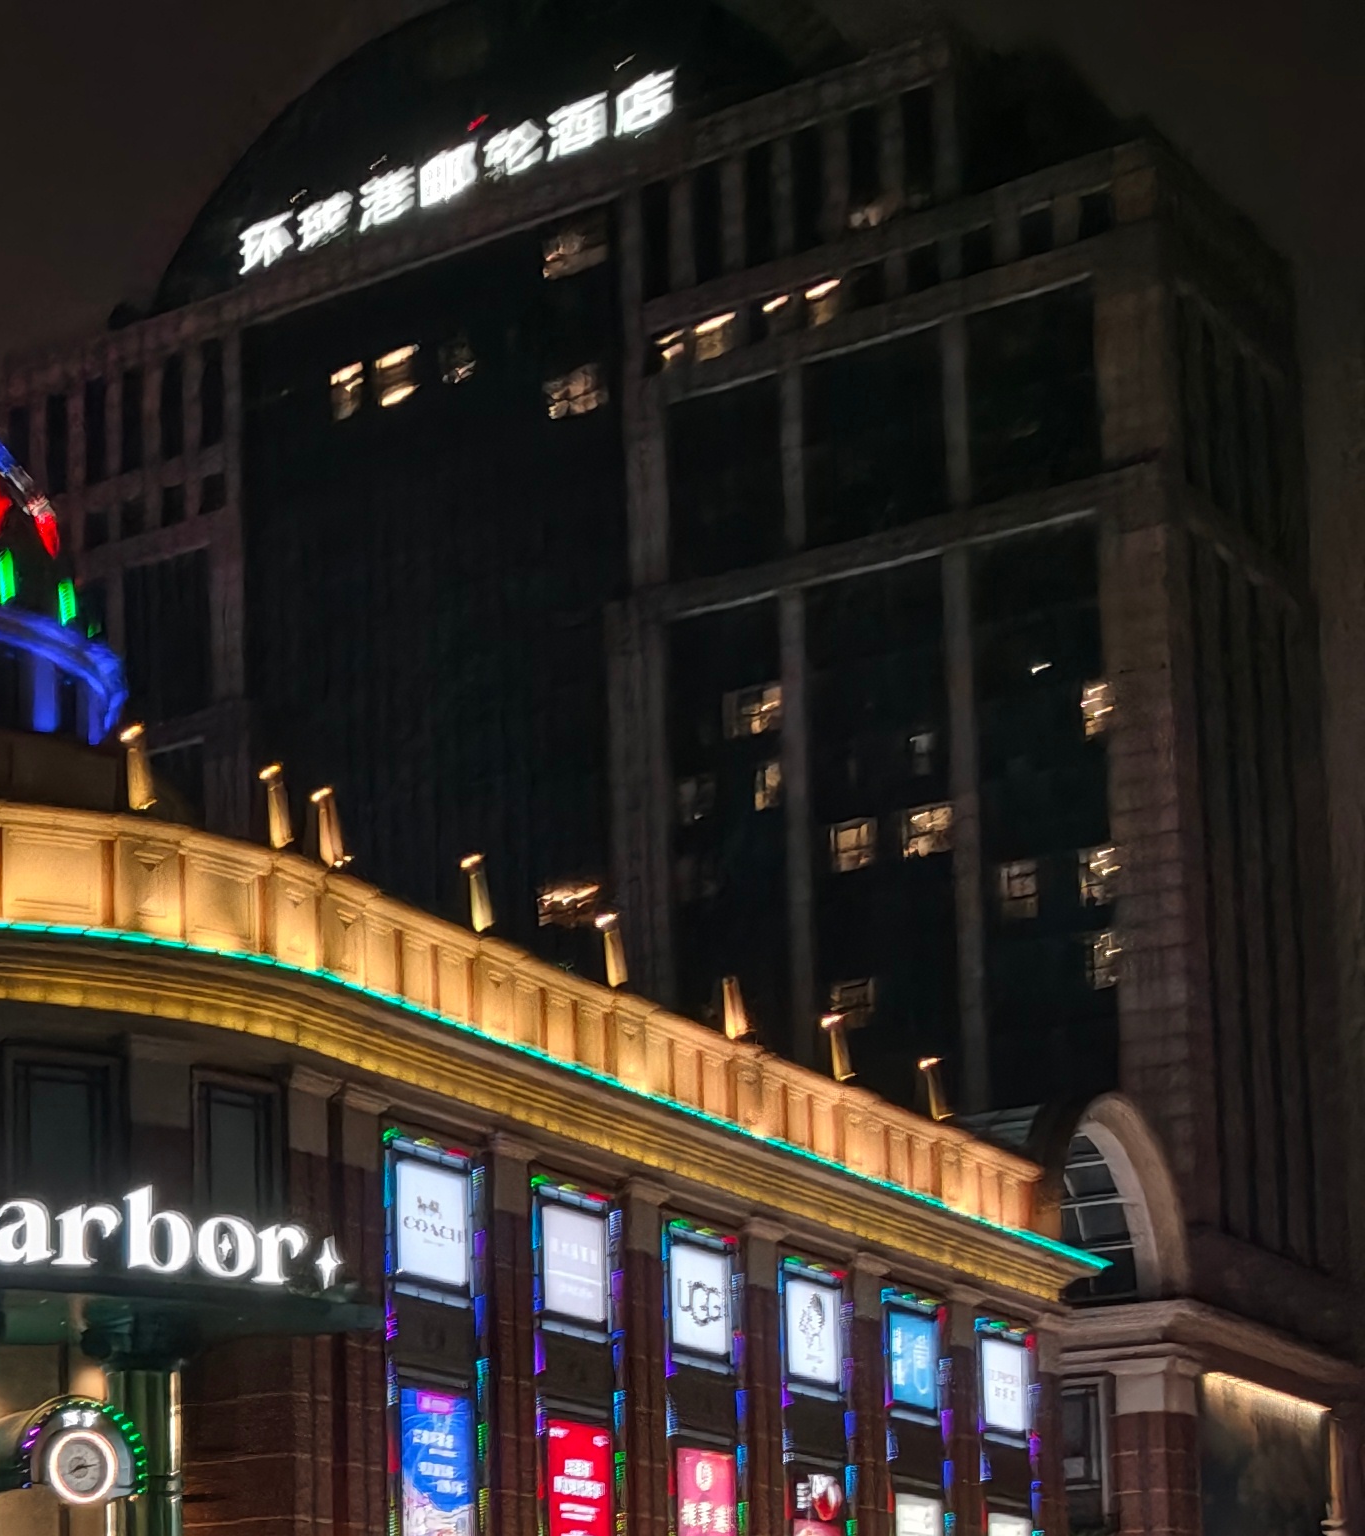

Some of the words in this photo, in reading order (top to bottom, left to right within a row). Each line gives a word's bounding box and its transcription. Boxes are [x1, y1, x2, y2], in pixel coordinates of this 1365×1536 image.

[238, 66, 677, 275] 环球港邮轮酒店
